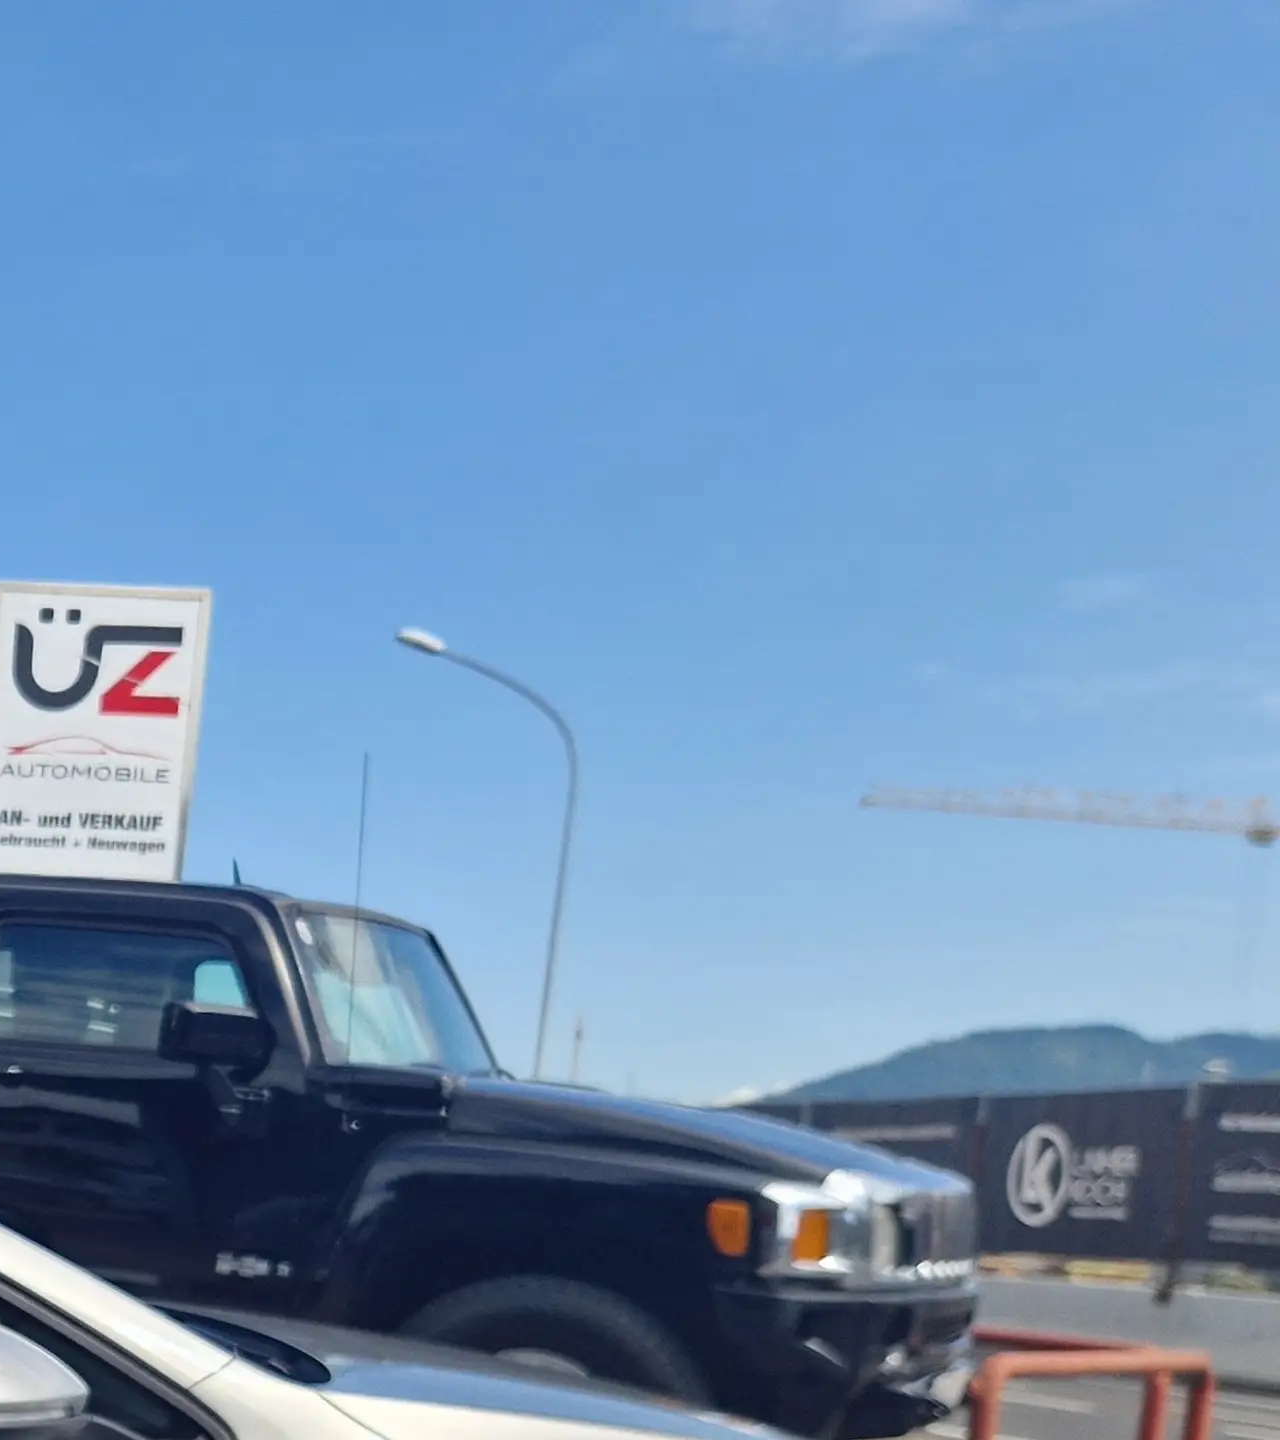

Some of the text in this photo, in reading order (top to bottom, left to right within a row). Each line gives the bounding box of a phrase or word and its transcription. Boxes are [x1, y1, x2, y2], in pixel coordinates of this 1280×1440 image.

[0, 763, 171, 784] AUTOMOBILE
[37, 813, 72, 829] und
[78, 812, 163, 832] VERKAUF
[86, 836, 166, 855] Neuwagen
